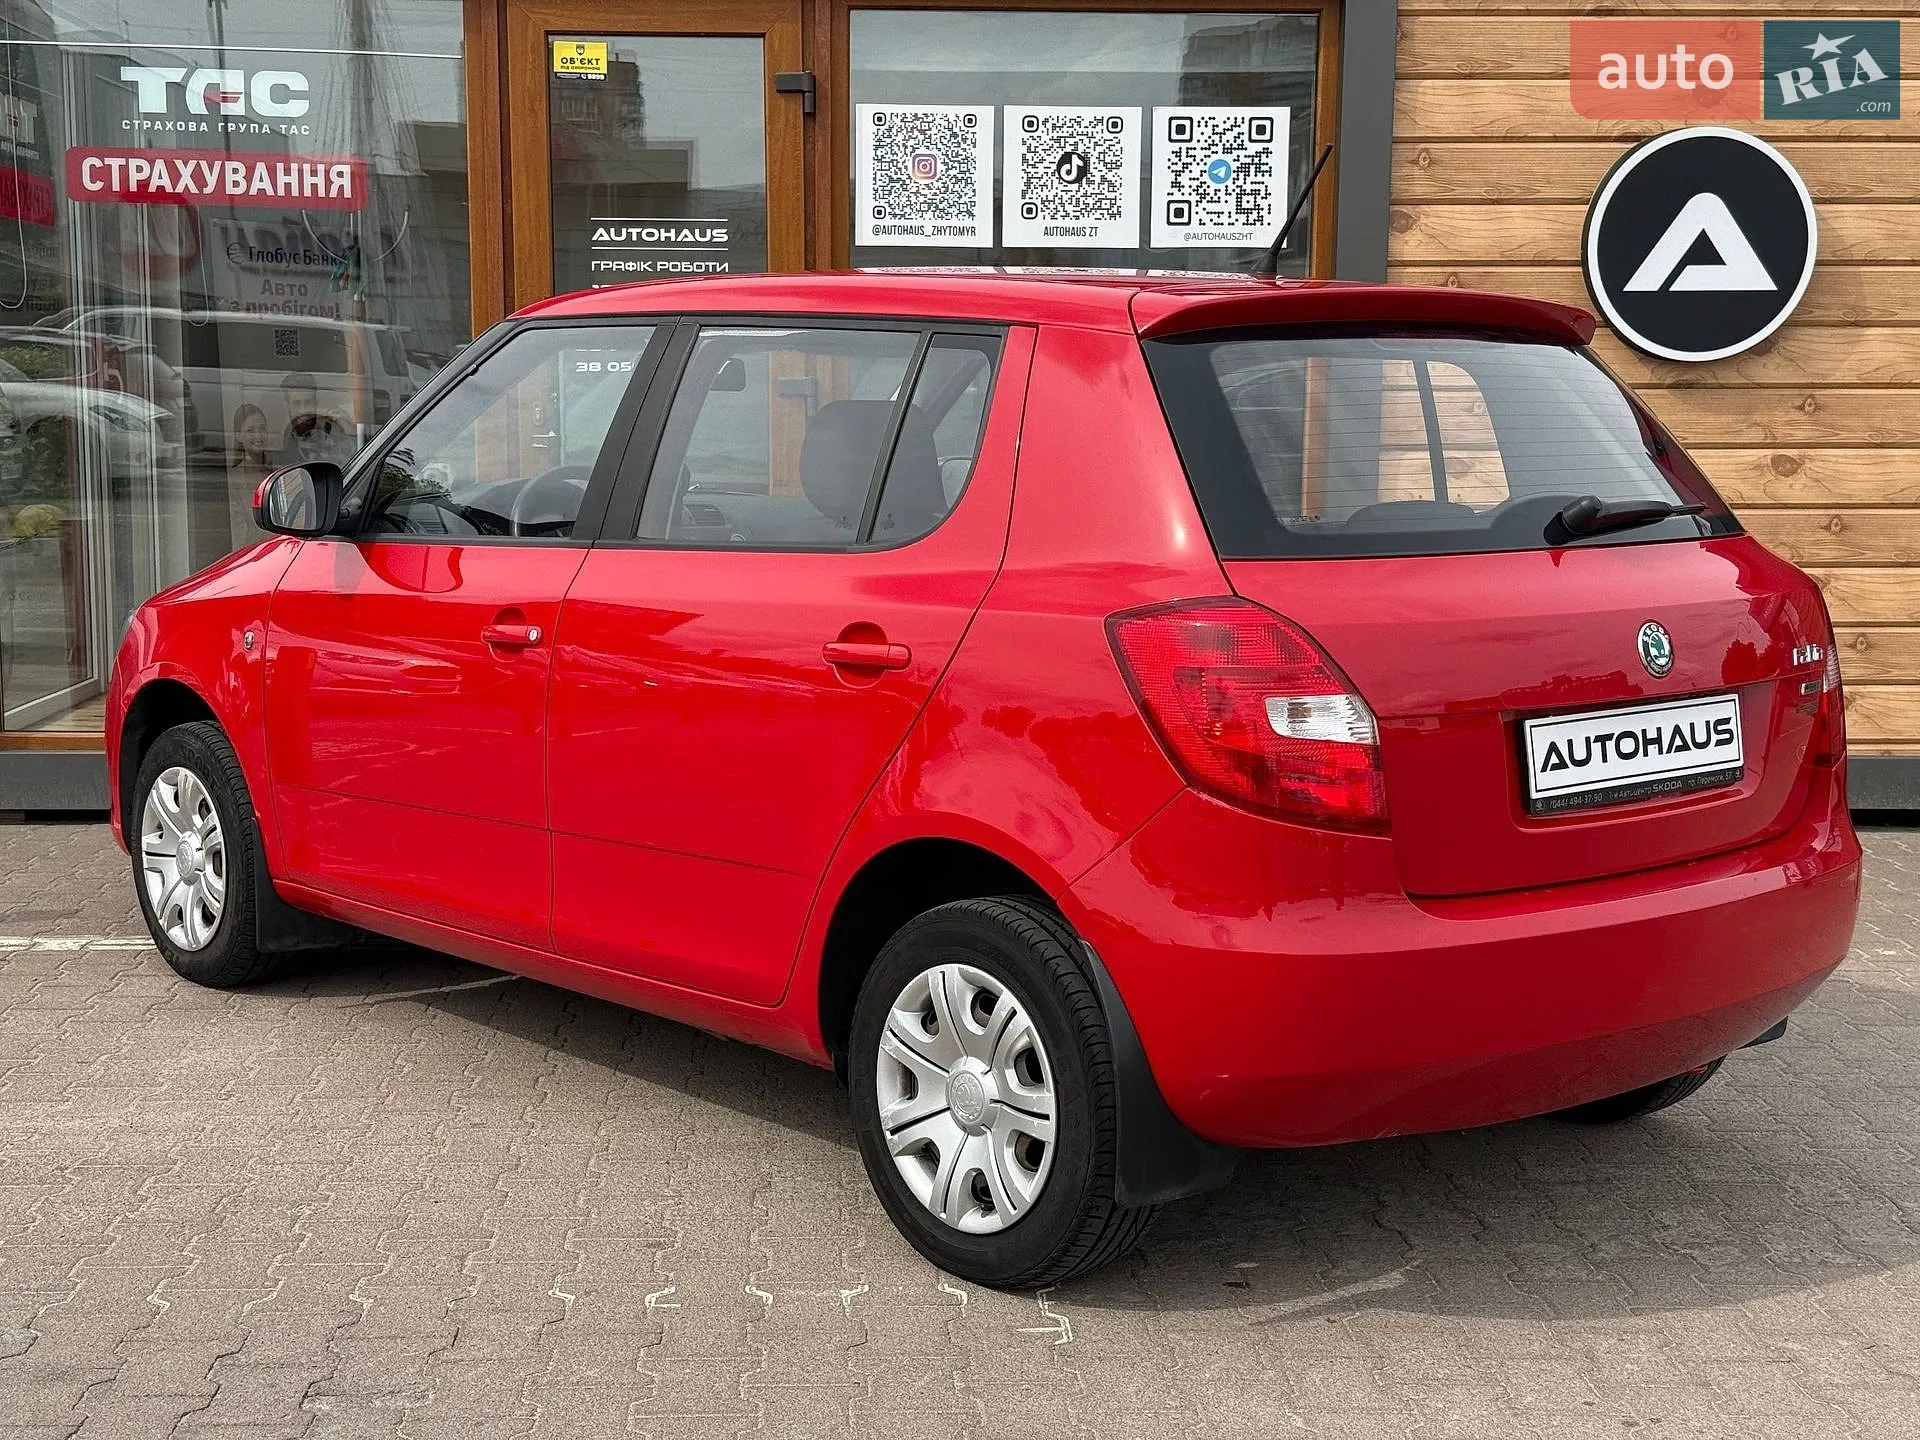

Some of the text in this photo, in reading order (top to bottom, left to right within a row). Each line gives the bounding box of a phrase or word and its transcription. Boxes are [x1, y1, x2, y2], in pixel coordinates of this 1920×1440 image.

[560, 57, 601, 65] ОБ'ЄКТ
[122, 120, 310, 136] СТРАХОВА ГРУПА ТАС
[81, 157, 353, 199] СТРАХУВАННЯ
[591, 227, 728, 242] AUTOHAUS
[872, 224, 977, 237] @AUTOHAUS_ZHYTOMYR
[1043, 225, 1099, 238] AUTOHAUS ZT
[1183, 232, 1254, 241] @AUTOHAUSZHT
[1622, 192, 1778, 292] A
[249, 246, 300, 268] Глобус
[591, 261, 728, 273] ГРАФІК РОБОТИ
[260, 279, 309, 298] Авто
[576, 361, 635, 372] 38 05
[1540, 717, 1734, 773] AUTOHAUS
[1652, 780, 1682, 793] SKODA
